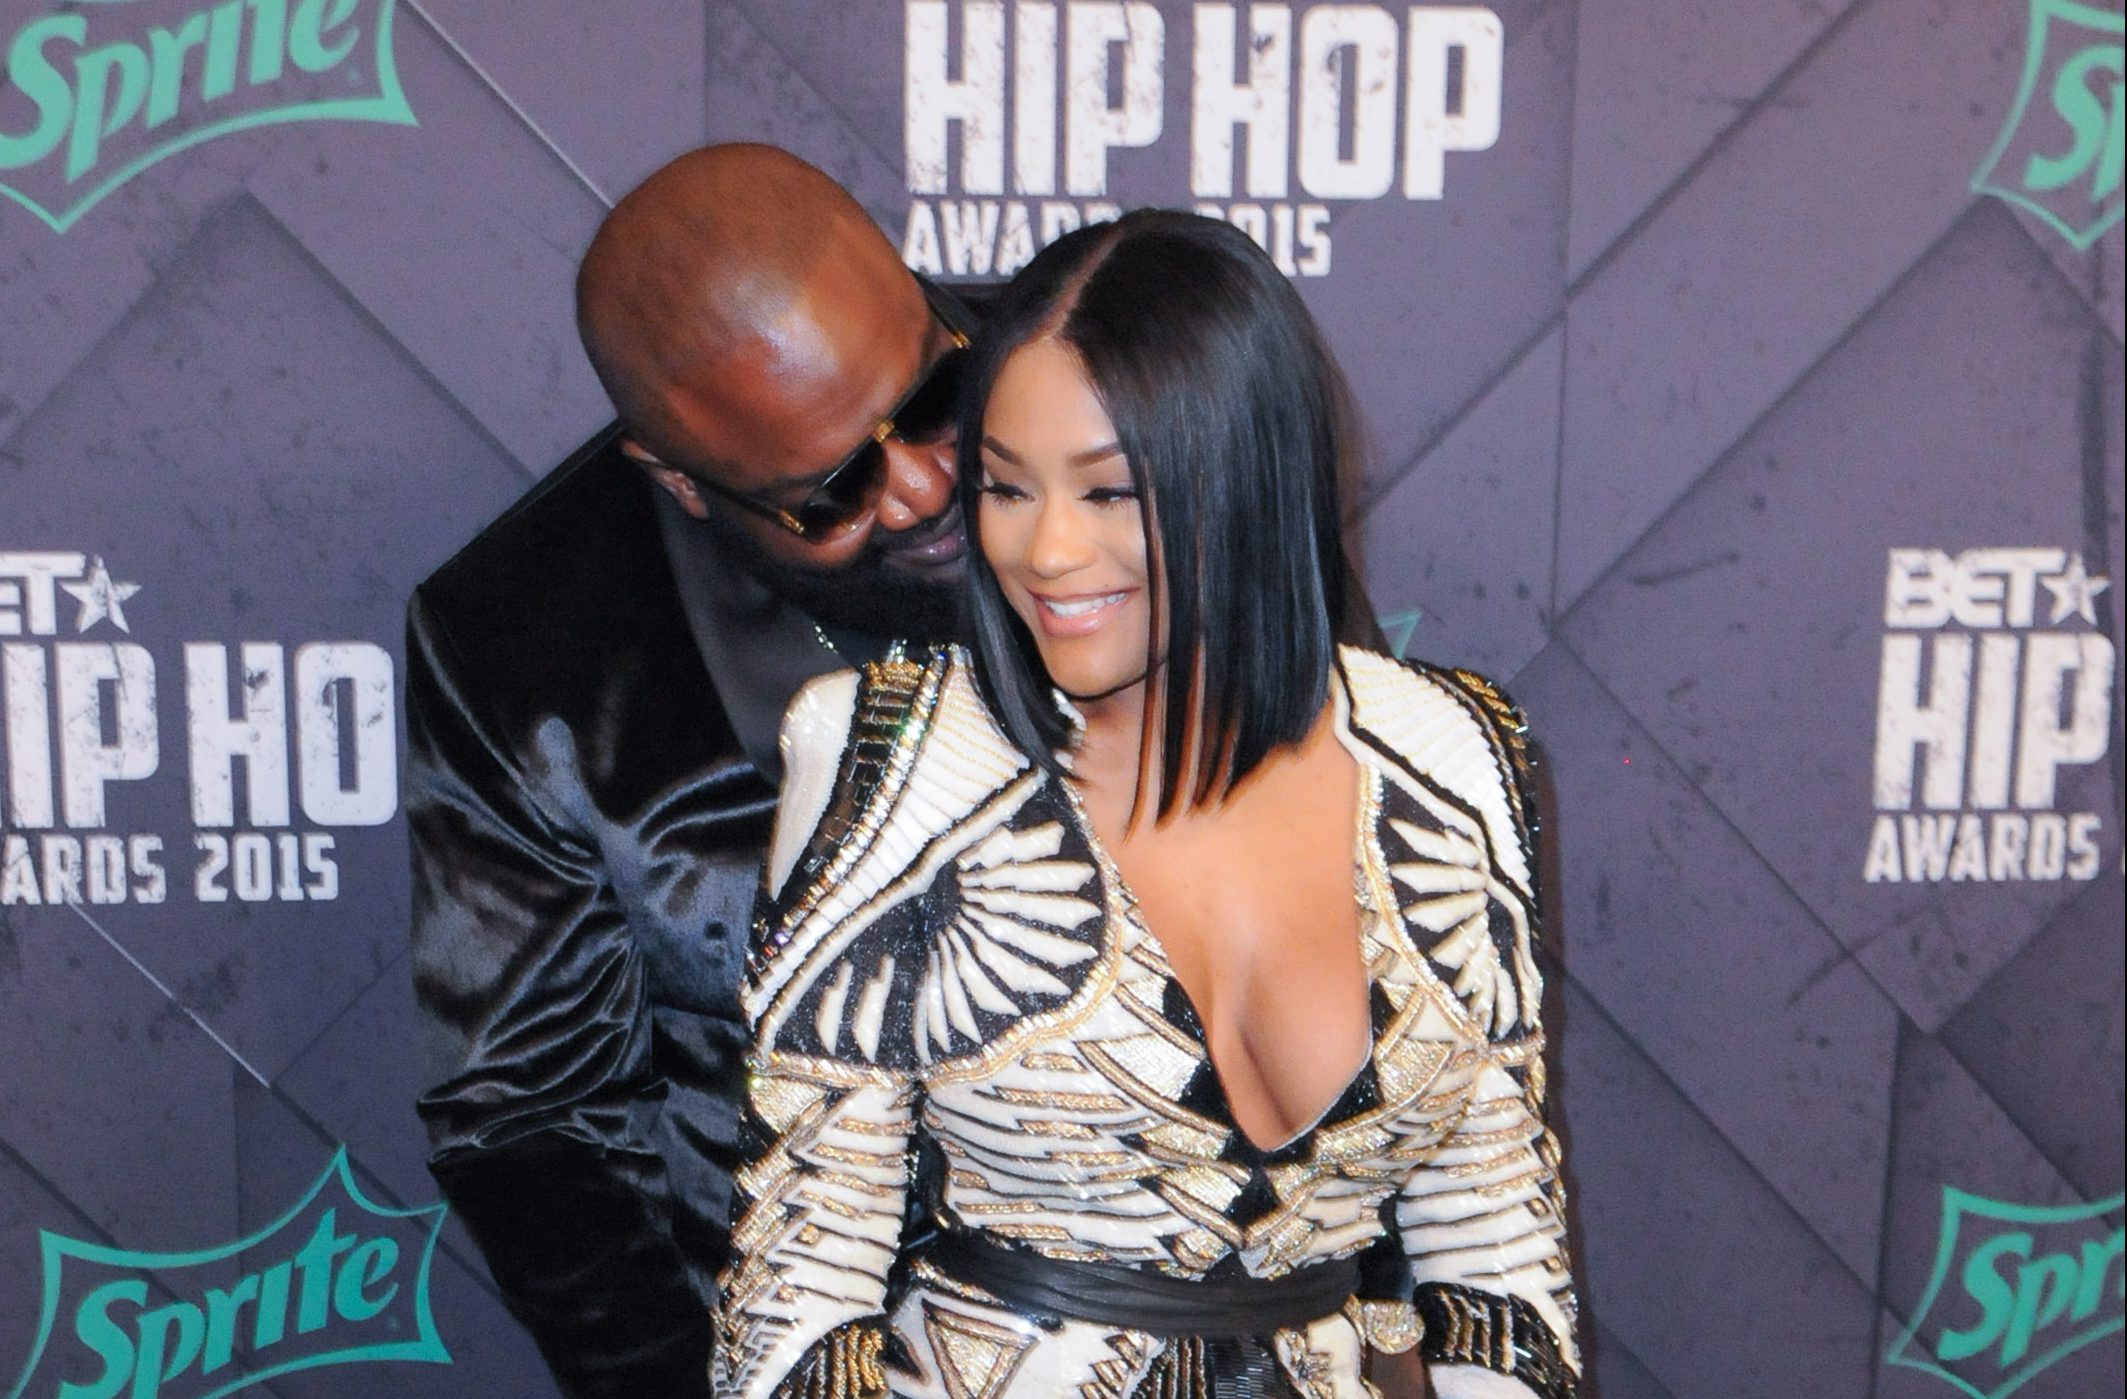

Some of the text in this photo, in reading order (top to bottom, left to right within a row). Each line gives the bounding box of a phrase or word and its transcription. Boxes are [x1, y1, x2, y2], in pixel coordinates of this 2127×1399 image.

[905, 0, 1504, 200] HIP HOP
[1884, 547, 2066, 628] BET
[0, 642, 160, 828] IP
[1874, 634, 2115, 810] HIP
[195, 833, 338, 901] 2015
[1864, 813, 2101, 882] AWARDS
[59, 1207, 399, 1399] Sprite
[1936, 1225, 2126, 1368] Spr
